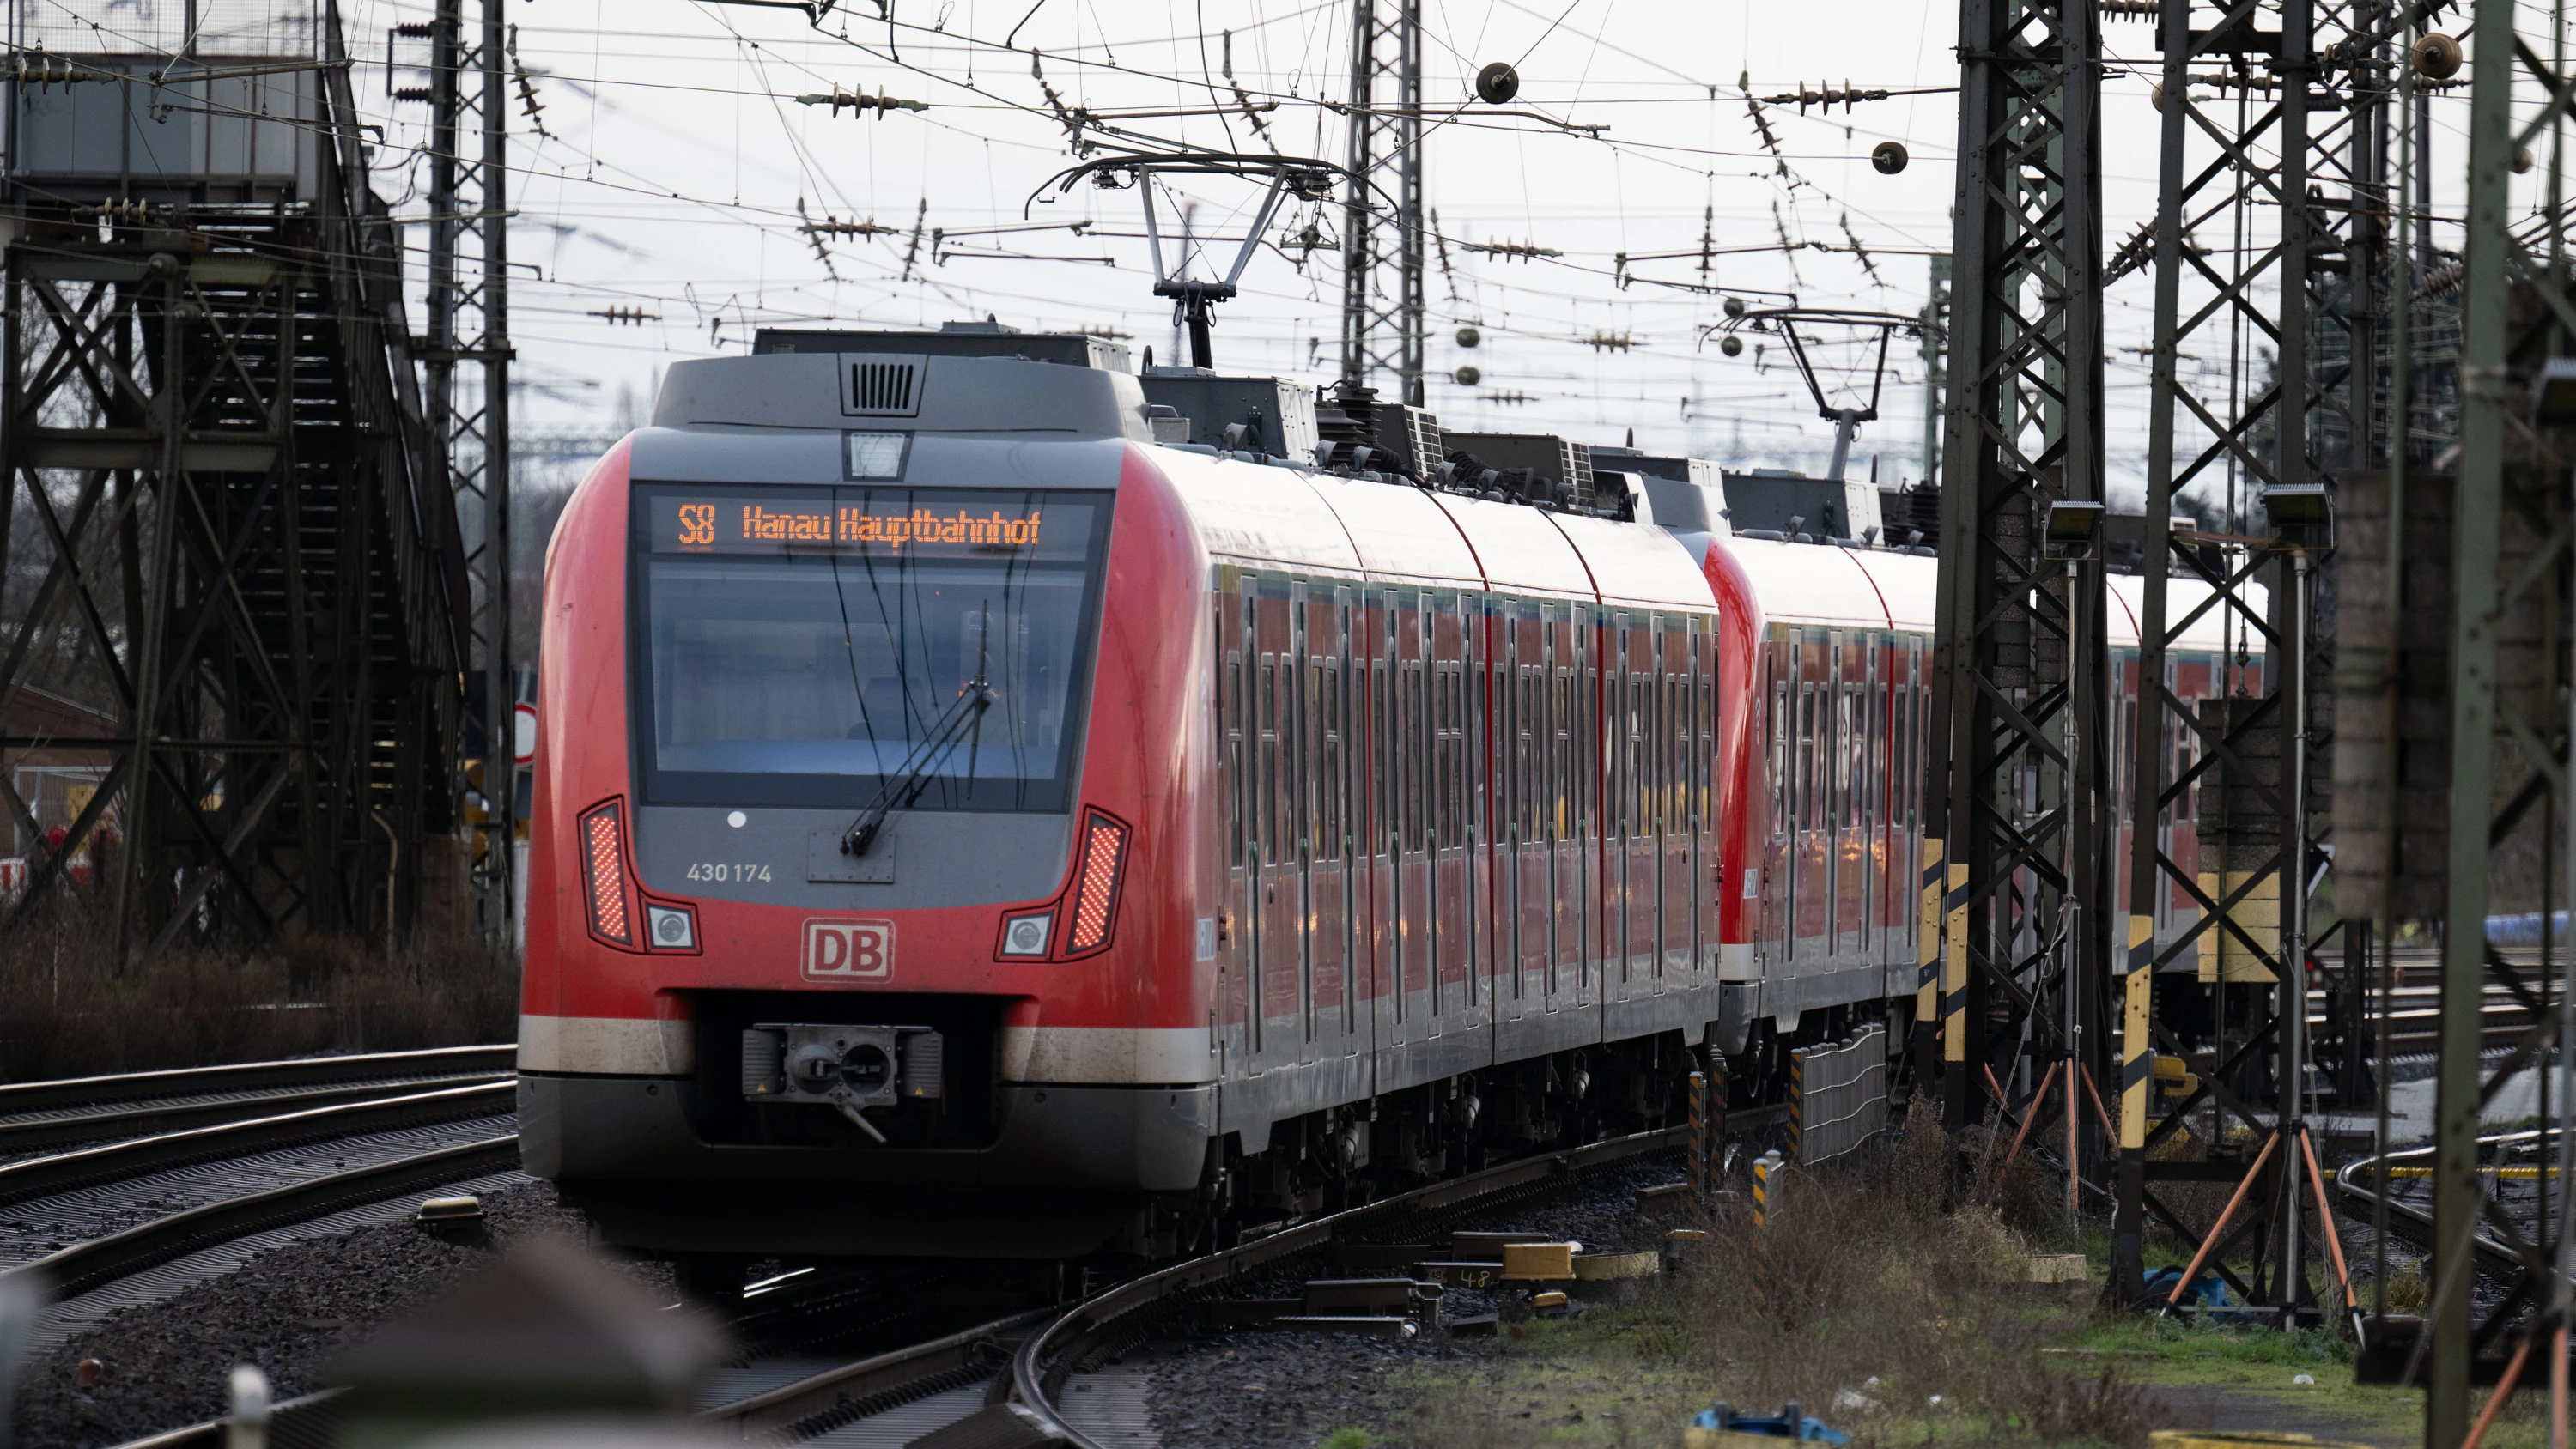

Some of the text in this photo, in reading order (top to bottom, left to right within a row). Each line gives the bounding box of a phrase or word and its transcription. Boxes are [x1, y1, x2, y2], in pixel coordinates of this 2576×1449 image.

[678, 504, 1041, 548] S8 Hanau Hauptbahnhof
[686, 863, 771, 882] 430 174
[814, 929, 883, 971] DB
[1461, 1270, 1491, 1288] 48
